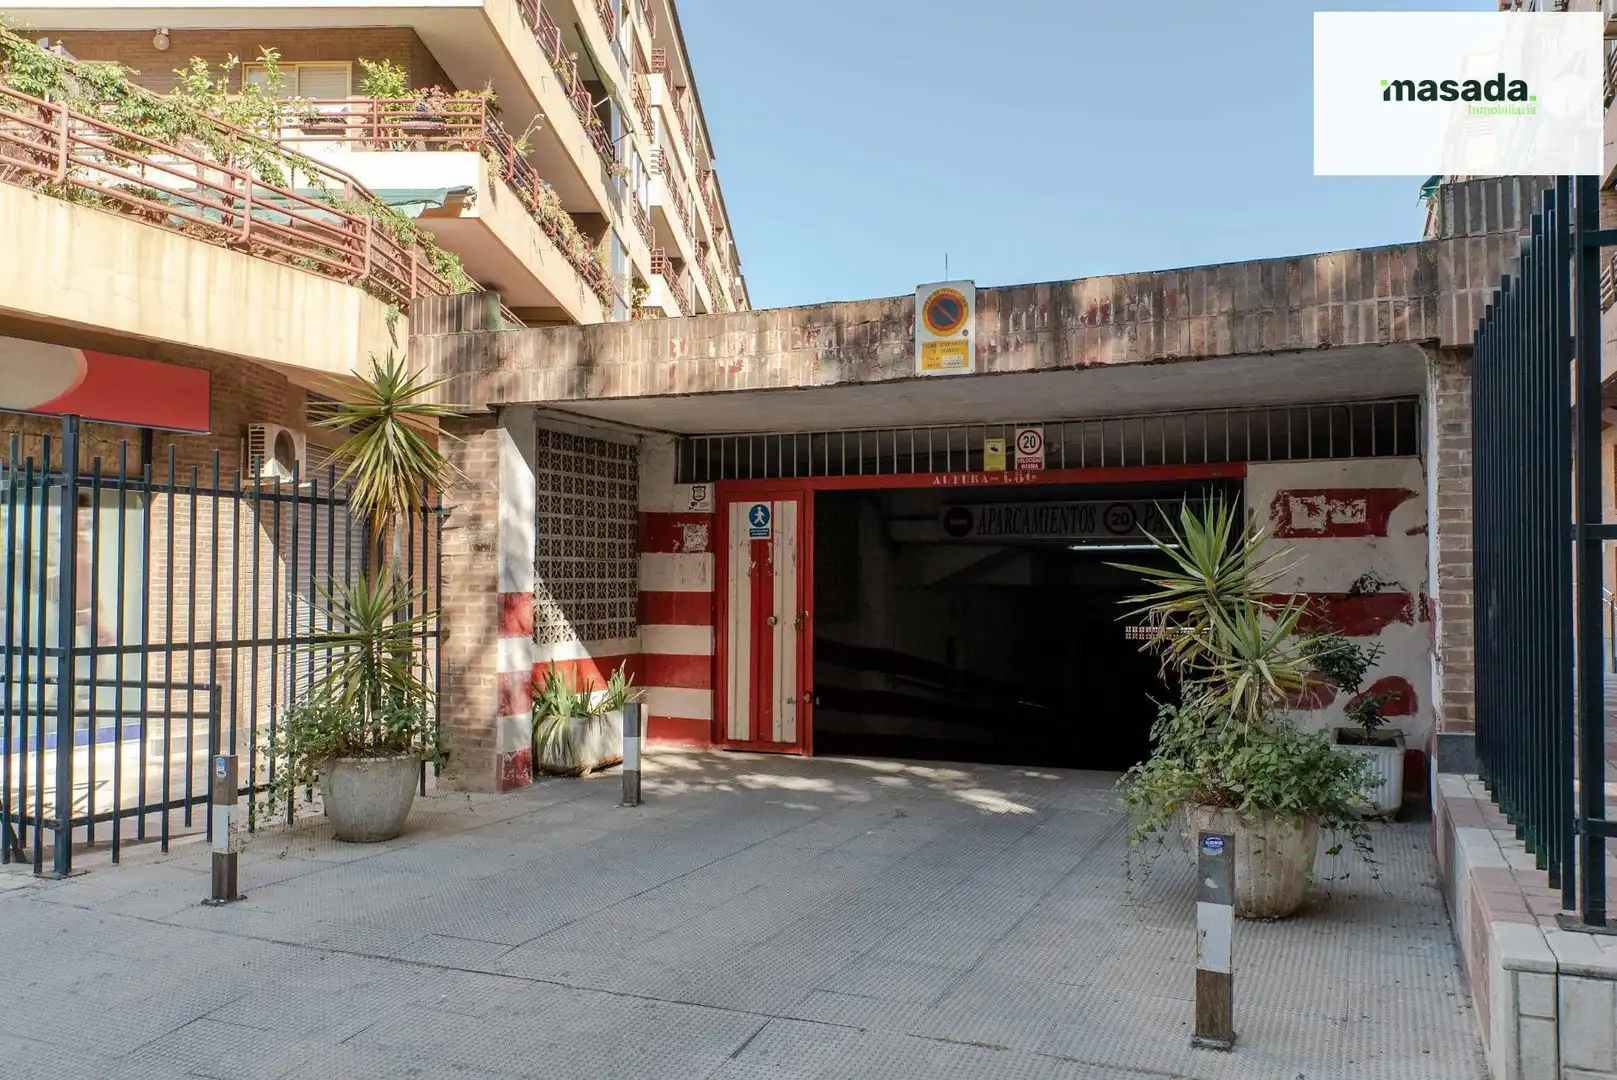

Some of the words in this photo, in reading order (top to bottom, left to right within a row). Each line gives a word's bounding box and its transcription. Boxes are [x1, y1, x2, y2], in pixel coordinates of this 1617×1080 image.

[1023, 436, 1036, 449] 20
[977, 504, 1096, 535] APARCAMIENTOS
[1111, 512, 1130, 525] 20
